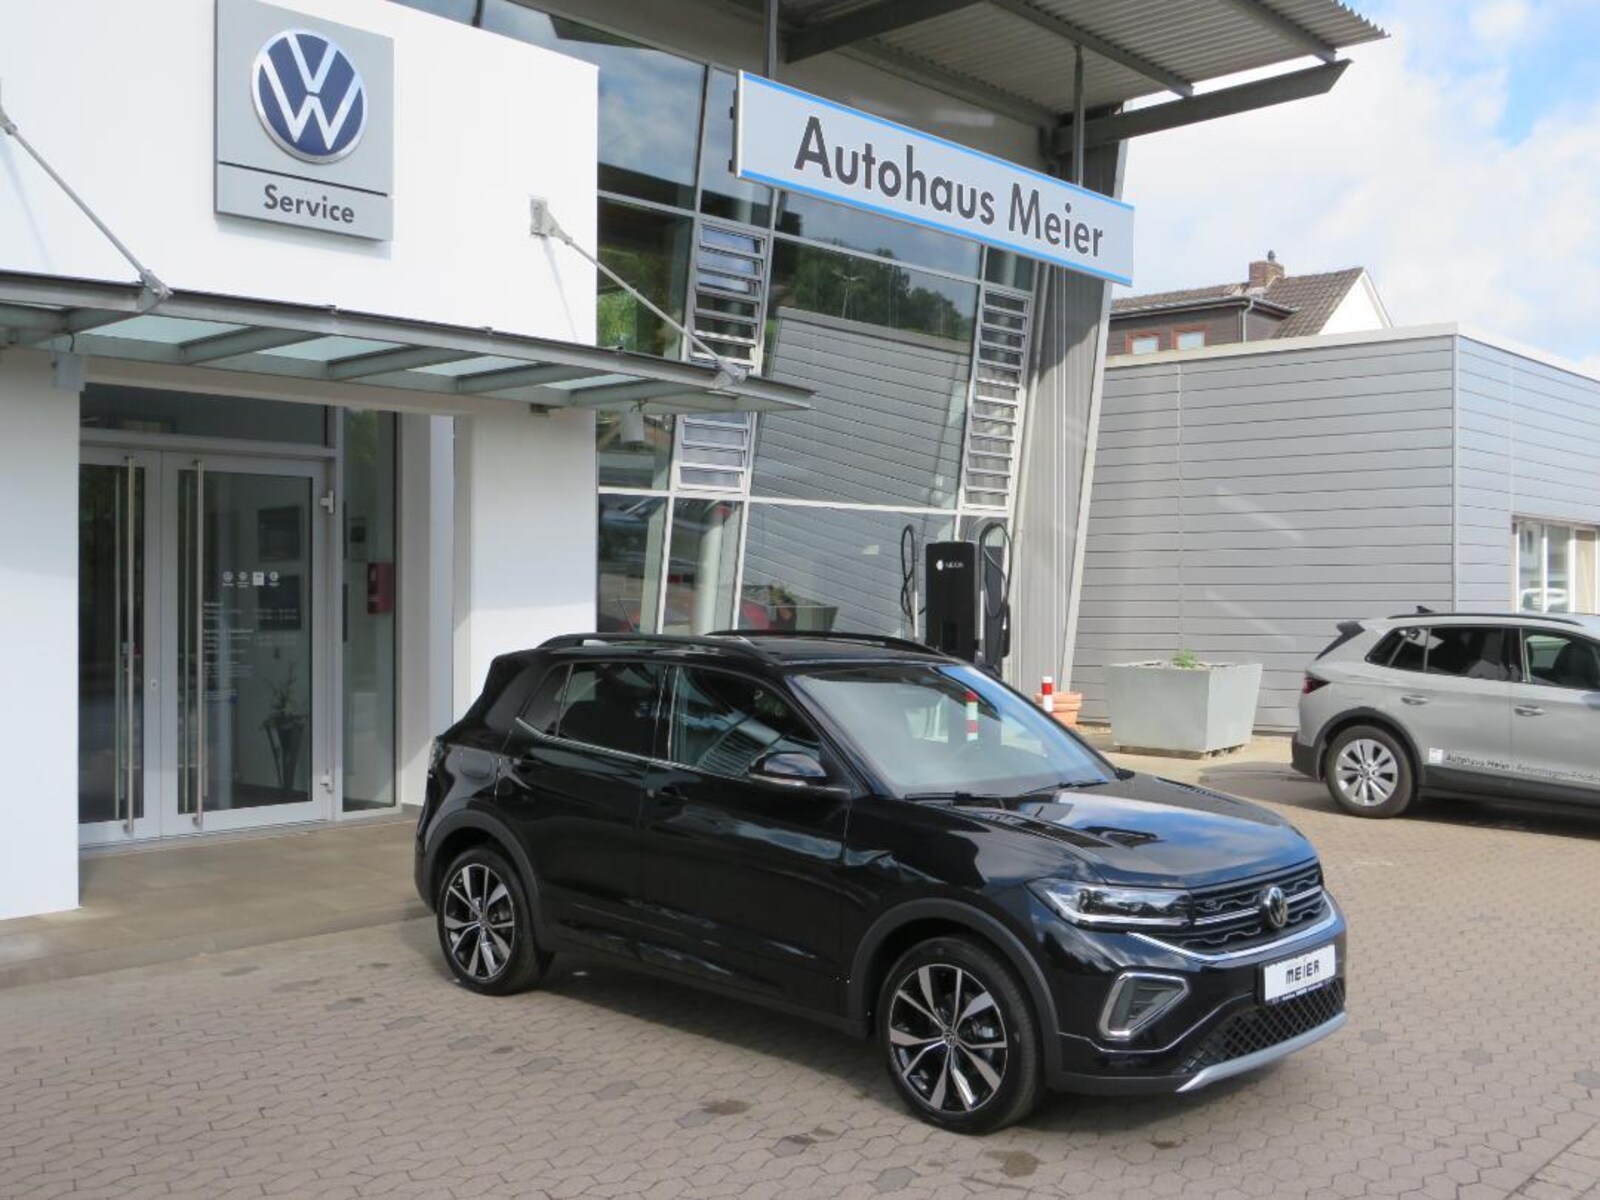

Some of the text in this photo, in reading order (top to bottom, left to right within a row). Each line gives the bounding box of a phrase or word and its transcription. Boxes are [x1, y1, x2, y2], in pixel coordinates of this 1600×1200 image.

[264, 184, 355, 223] Service
[794, 116, 1103, 258] Autohaus Meier
[1286, 960, 1320, 984] MEIER
